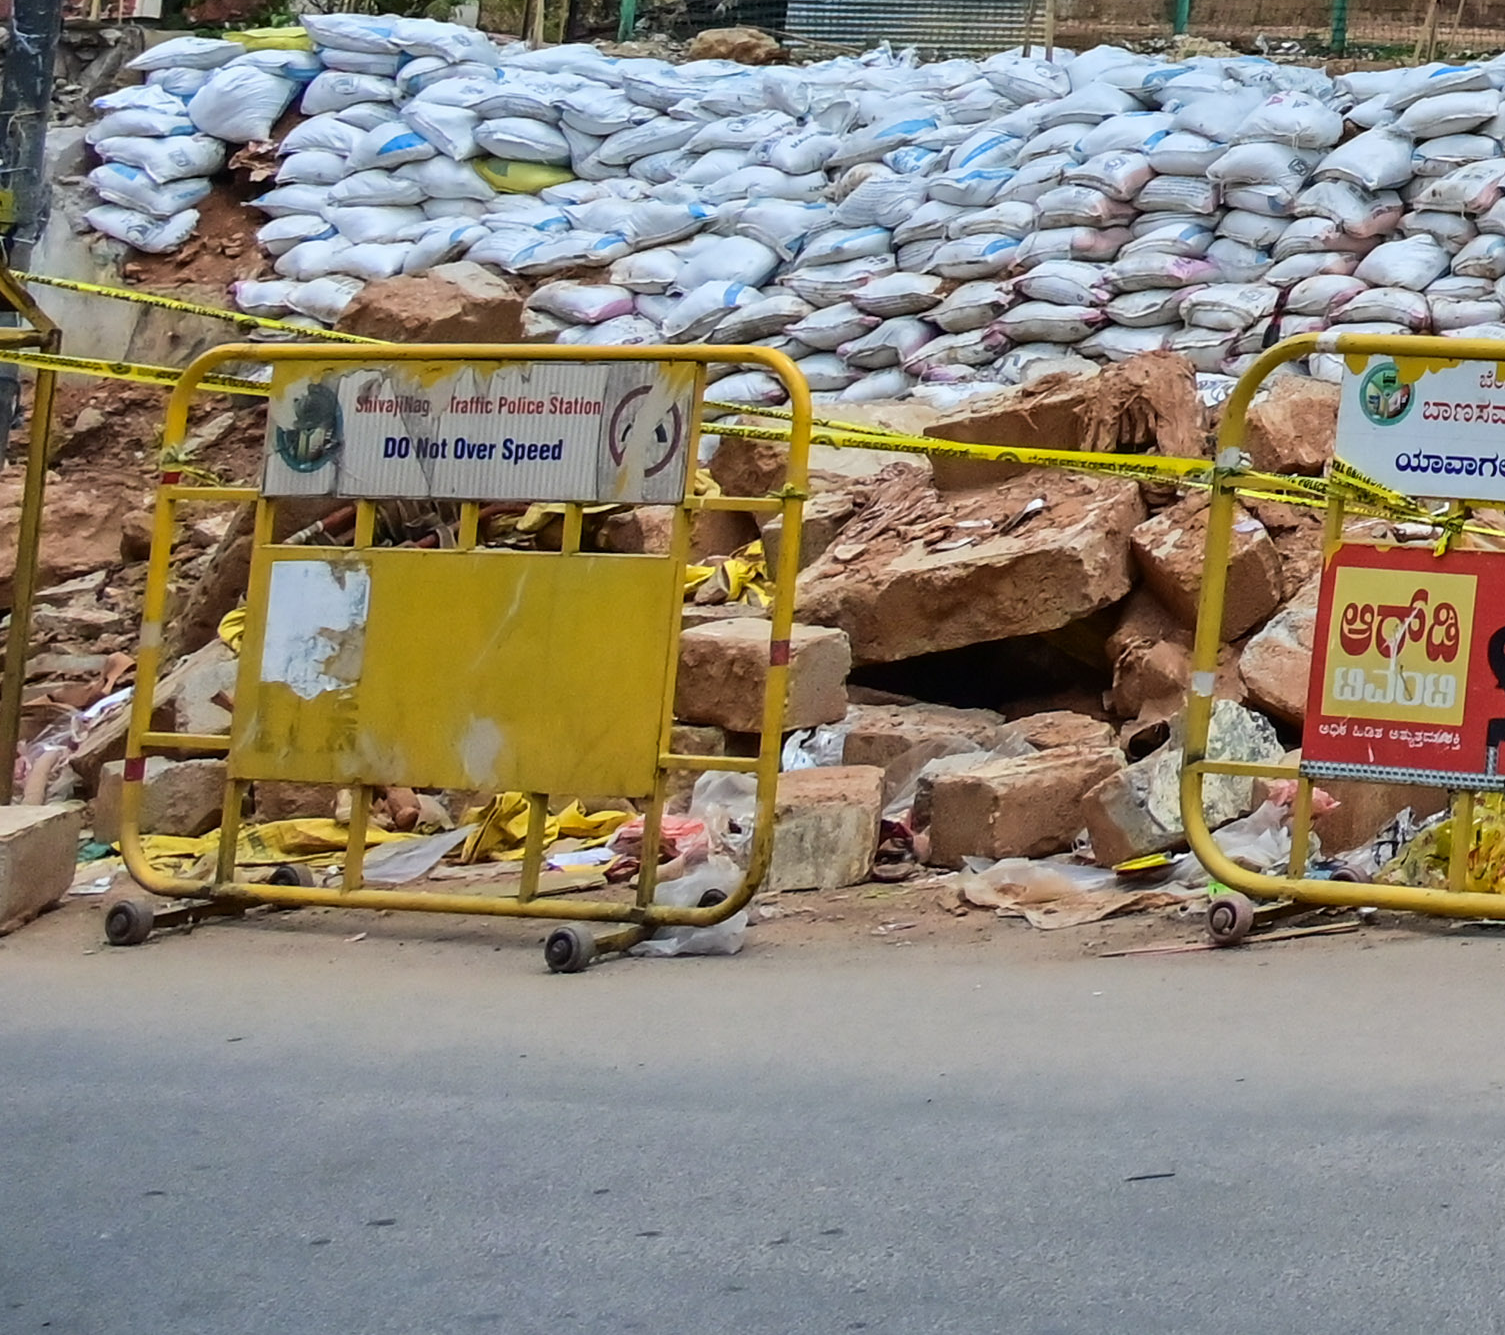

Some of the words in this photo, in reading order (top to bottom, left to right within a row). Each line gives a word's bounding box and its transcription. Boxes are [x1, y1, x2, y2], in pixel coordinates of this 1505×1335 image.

[449, 395, 493, 415] Traffic
[498, 396, 545, 415] Police
[549, 397, 601, 416] Station
[383, 436, 410, 460] DO
[416, 437, 447, 460] Not
[454, 437, 496, 461] Over
[502, 438, 563, 465] Speed
